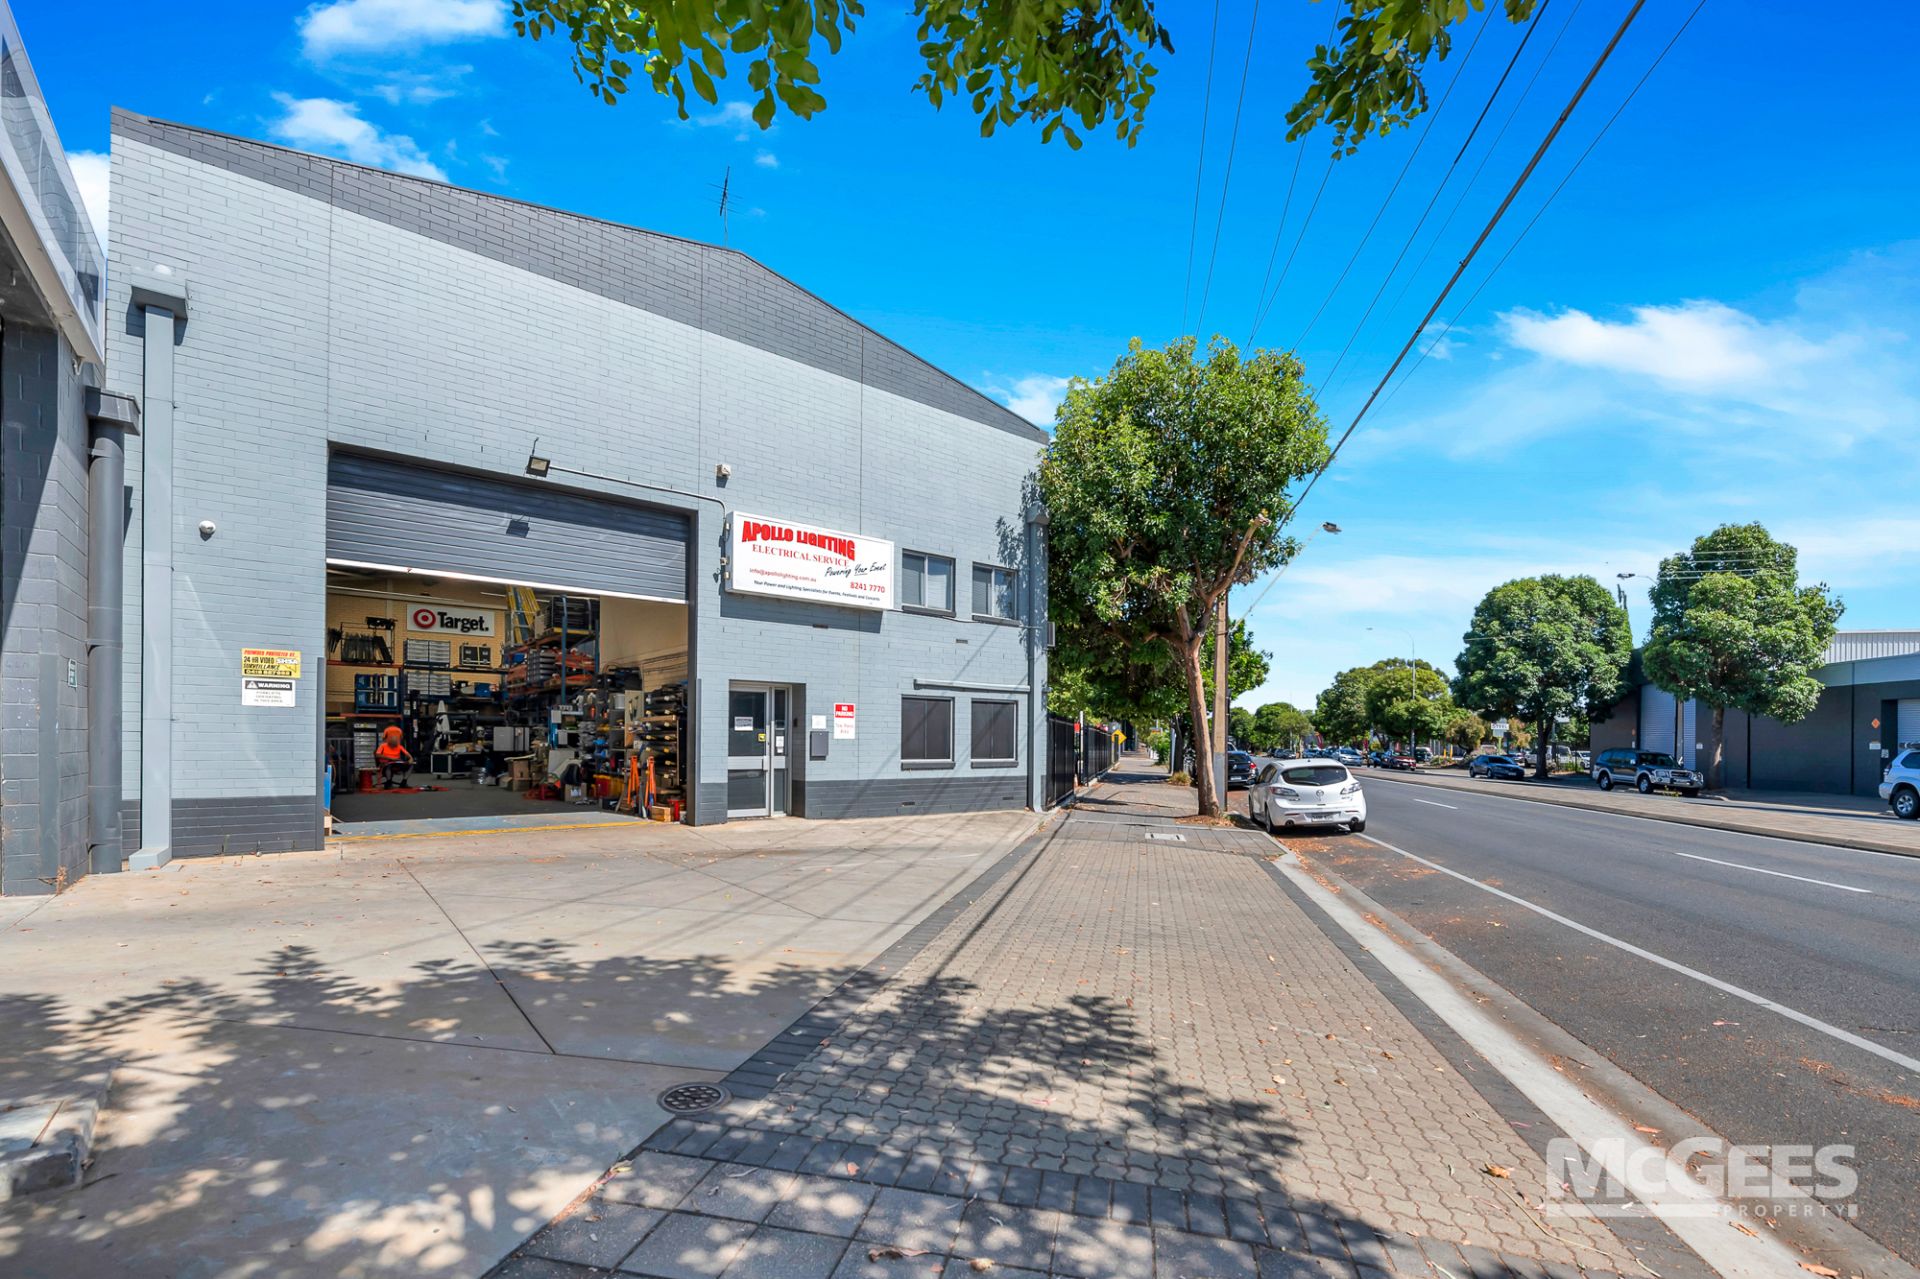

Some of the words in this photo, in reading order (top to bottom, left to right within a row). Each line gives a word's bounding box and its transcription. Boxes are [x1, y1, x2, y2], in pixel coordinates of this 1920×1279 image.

[742, 520, 794, 542] APOLLO
[796, 530, 855, 561] LIGHTING
[752, 544, 812, 561] ELECTRICAL
[813, 553, 849, 567] SERVICE
[824, 566, 852, 578] Powering
[854, 563, 868, 576] Your
[869, 562, 887, 572] Event
[850, 581, 867, 591] 8241
[869, 584, 886, 594] 7770
[437, 611, 489, 633] Target.
